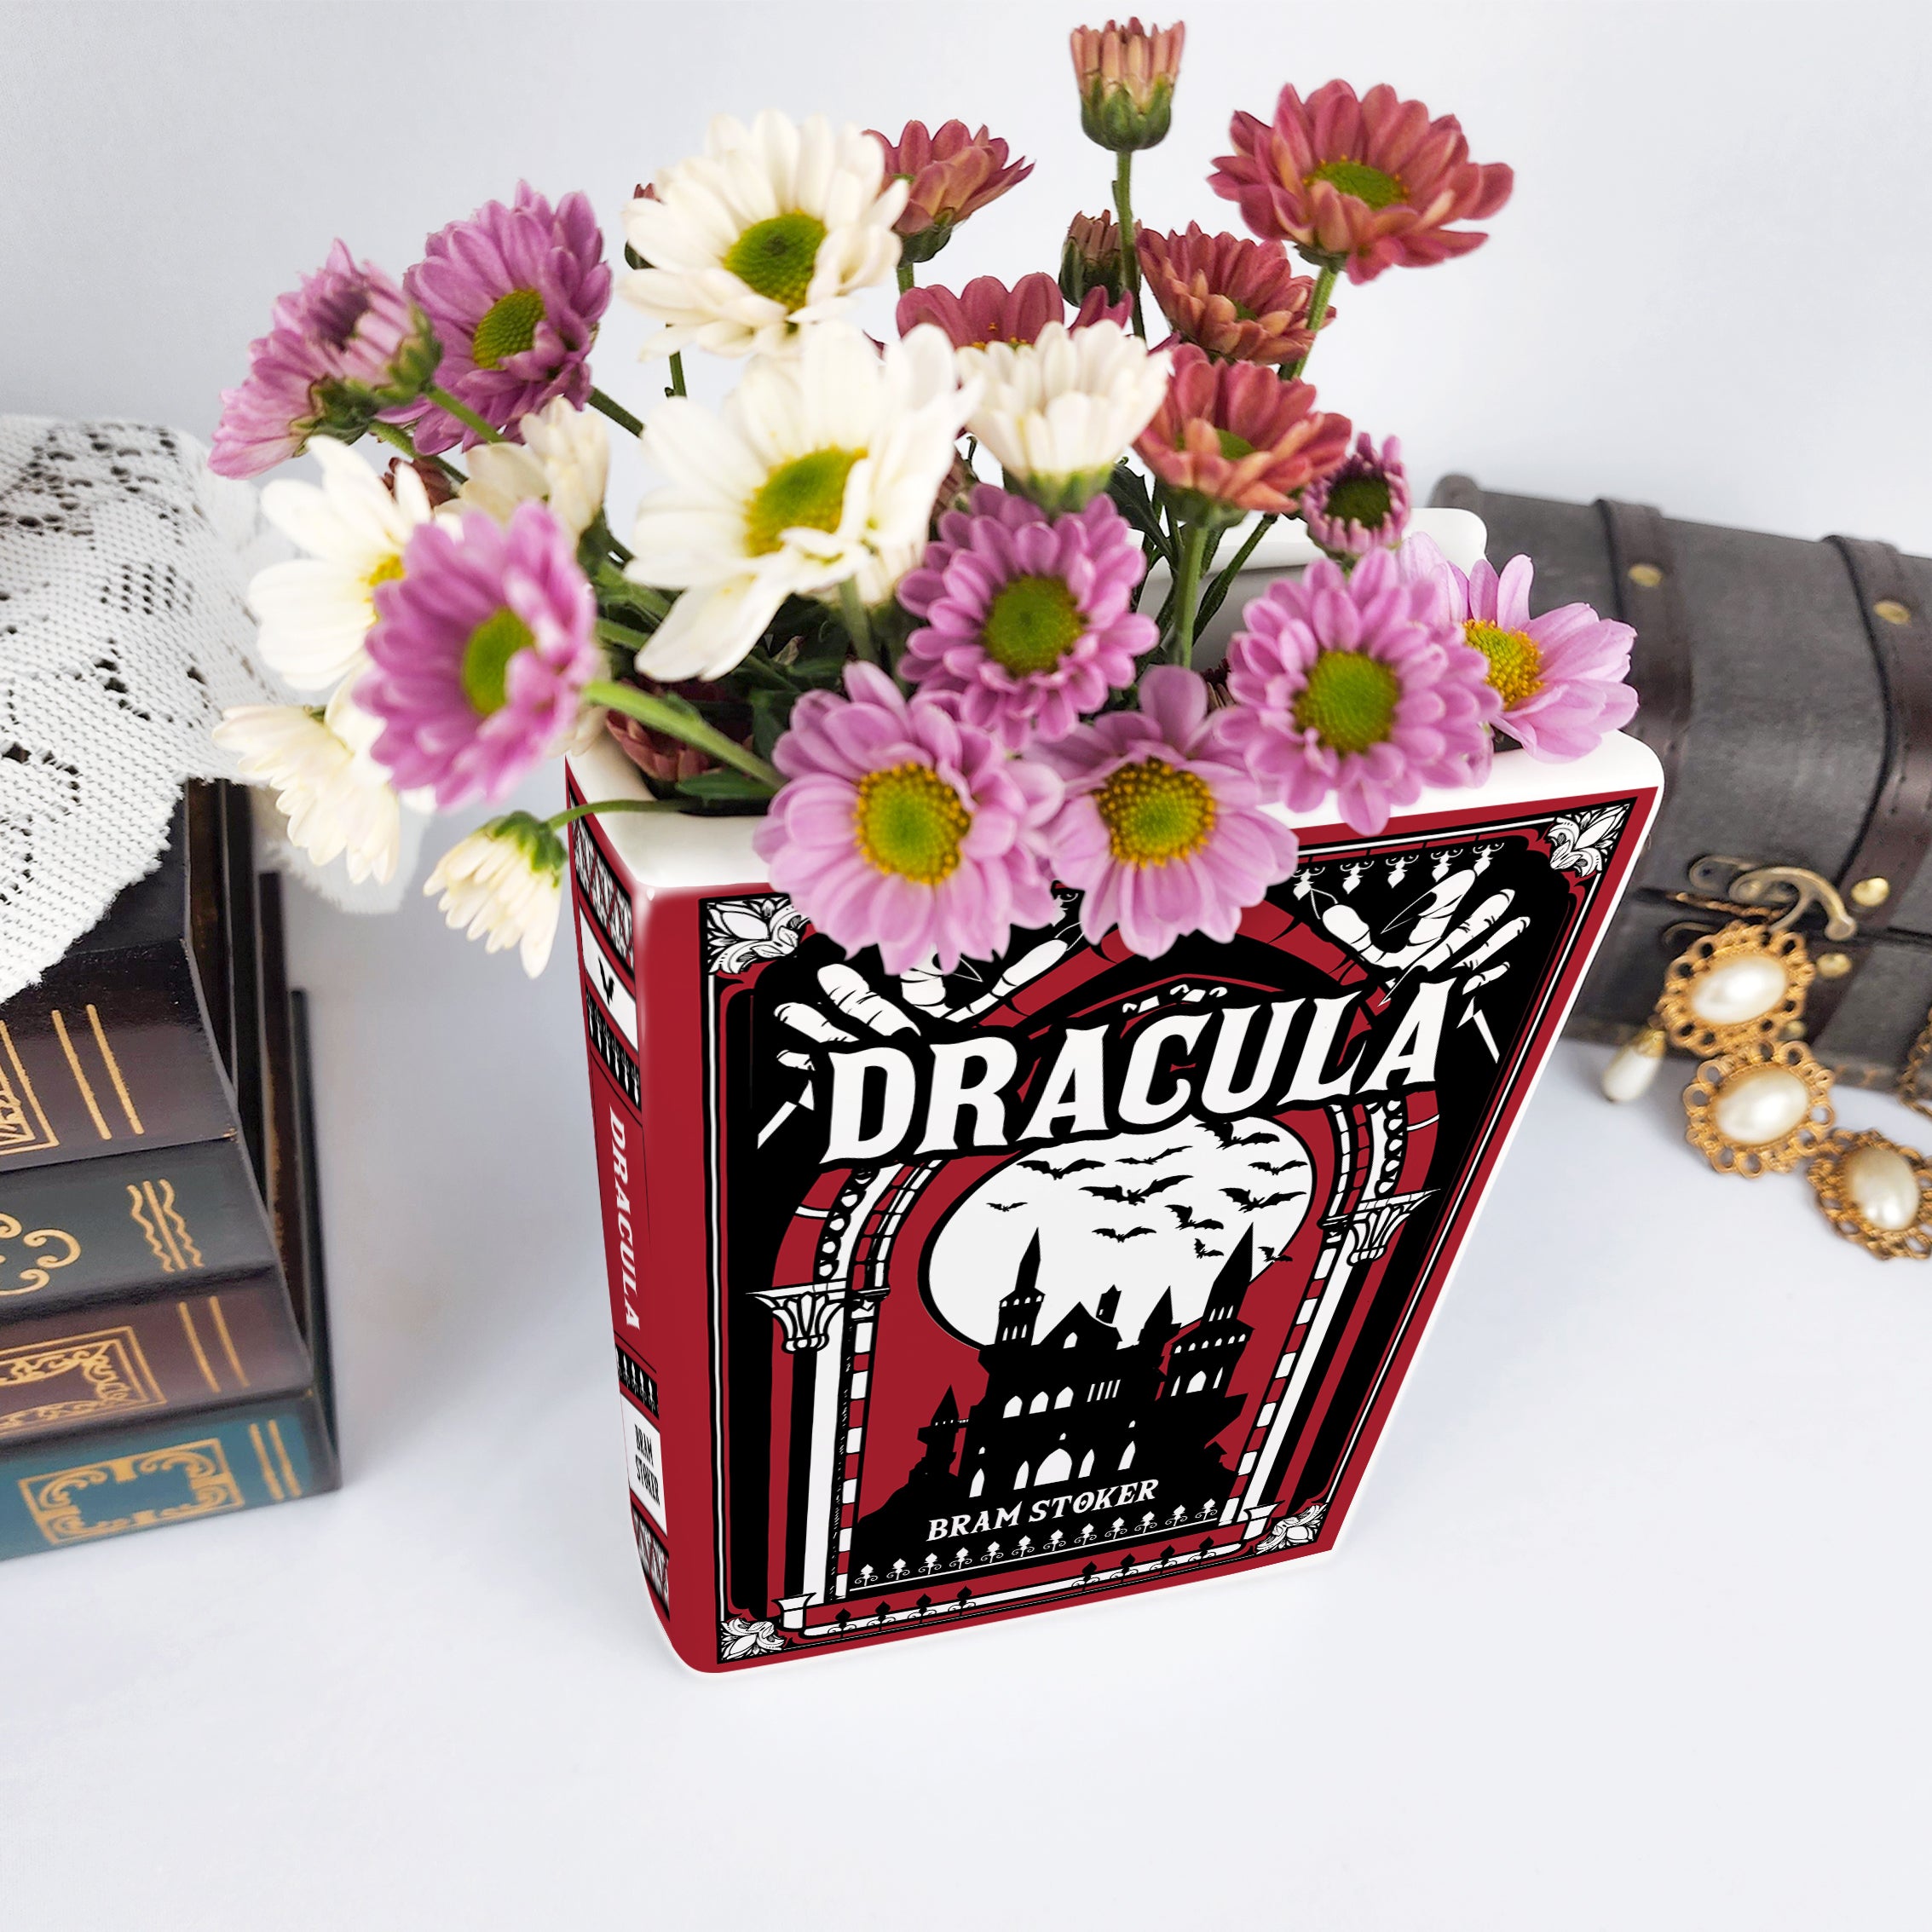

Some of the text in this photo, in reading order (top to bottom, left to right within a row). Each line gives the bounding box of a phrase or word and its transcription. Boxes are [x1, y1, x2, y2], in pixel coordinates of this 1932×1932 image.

[822, 978, 1456, 1164] DRACULA
[609, 1105, 640, 1329] DRACULA
[634, 1424, 654, 1468] BRAM
[635, 1454, 660, 1506] STOKER
[926, 1479, 1159, 1542] BRAM STOKER
